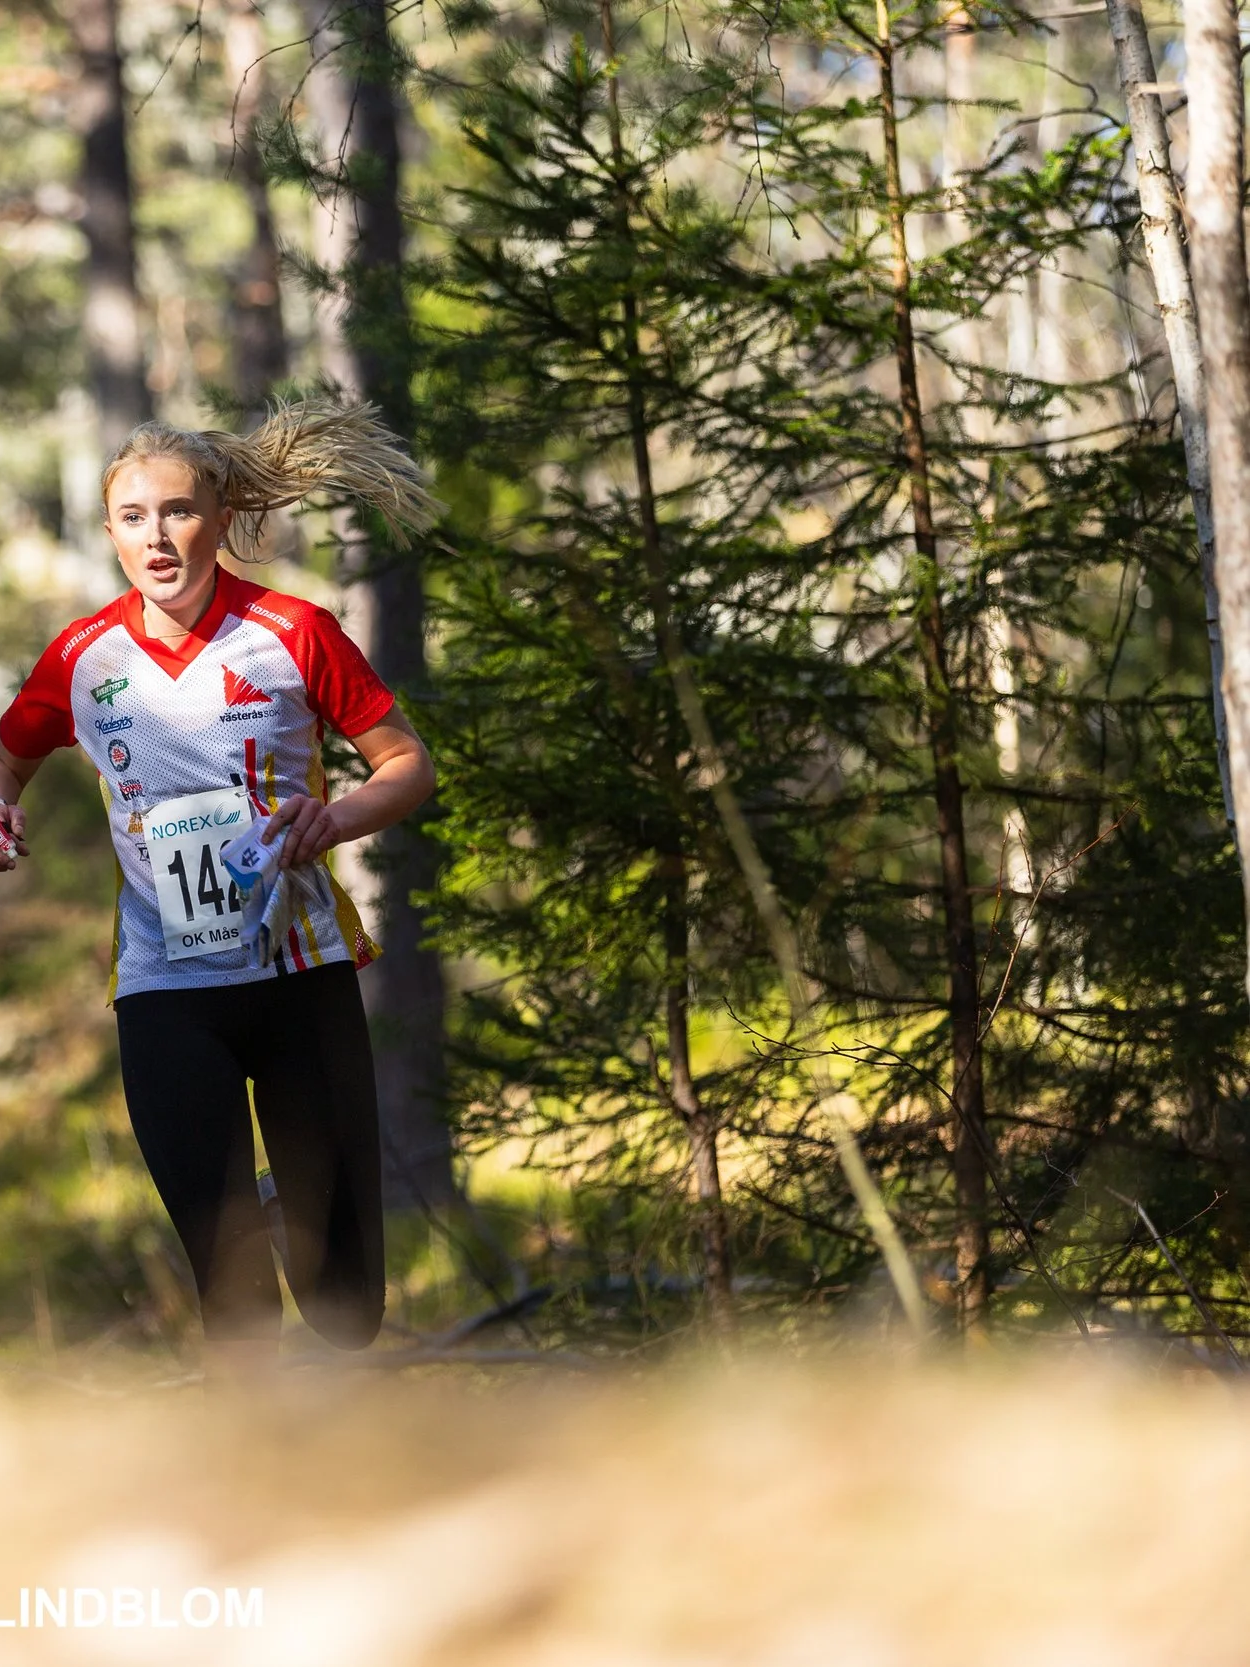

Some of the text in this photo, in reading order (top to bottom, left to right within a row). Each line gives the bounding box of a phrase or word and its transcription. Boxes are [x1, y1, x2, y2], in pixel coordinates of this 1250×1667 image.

[245, 602, 294, 631] noname
[61, 619, 106, 662] noname
[151, 814, 213, 840] NOREX
[182, 933, 206, 948] OK
